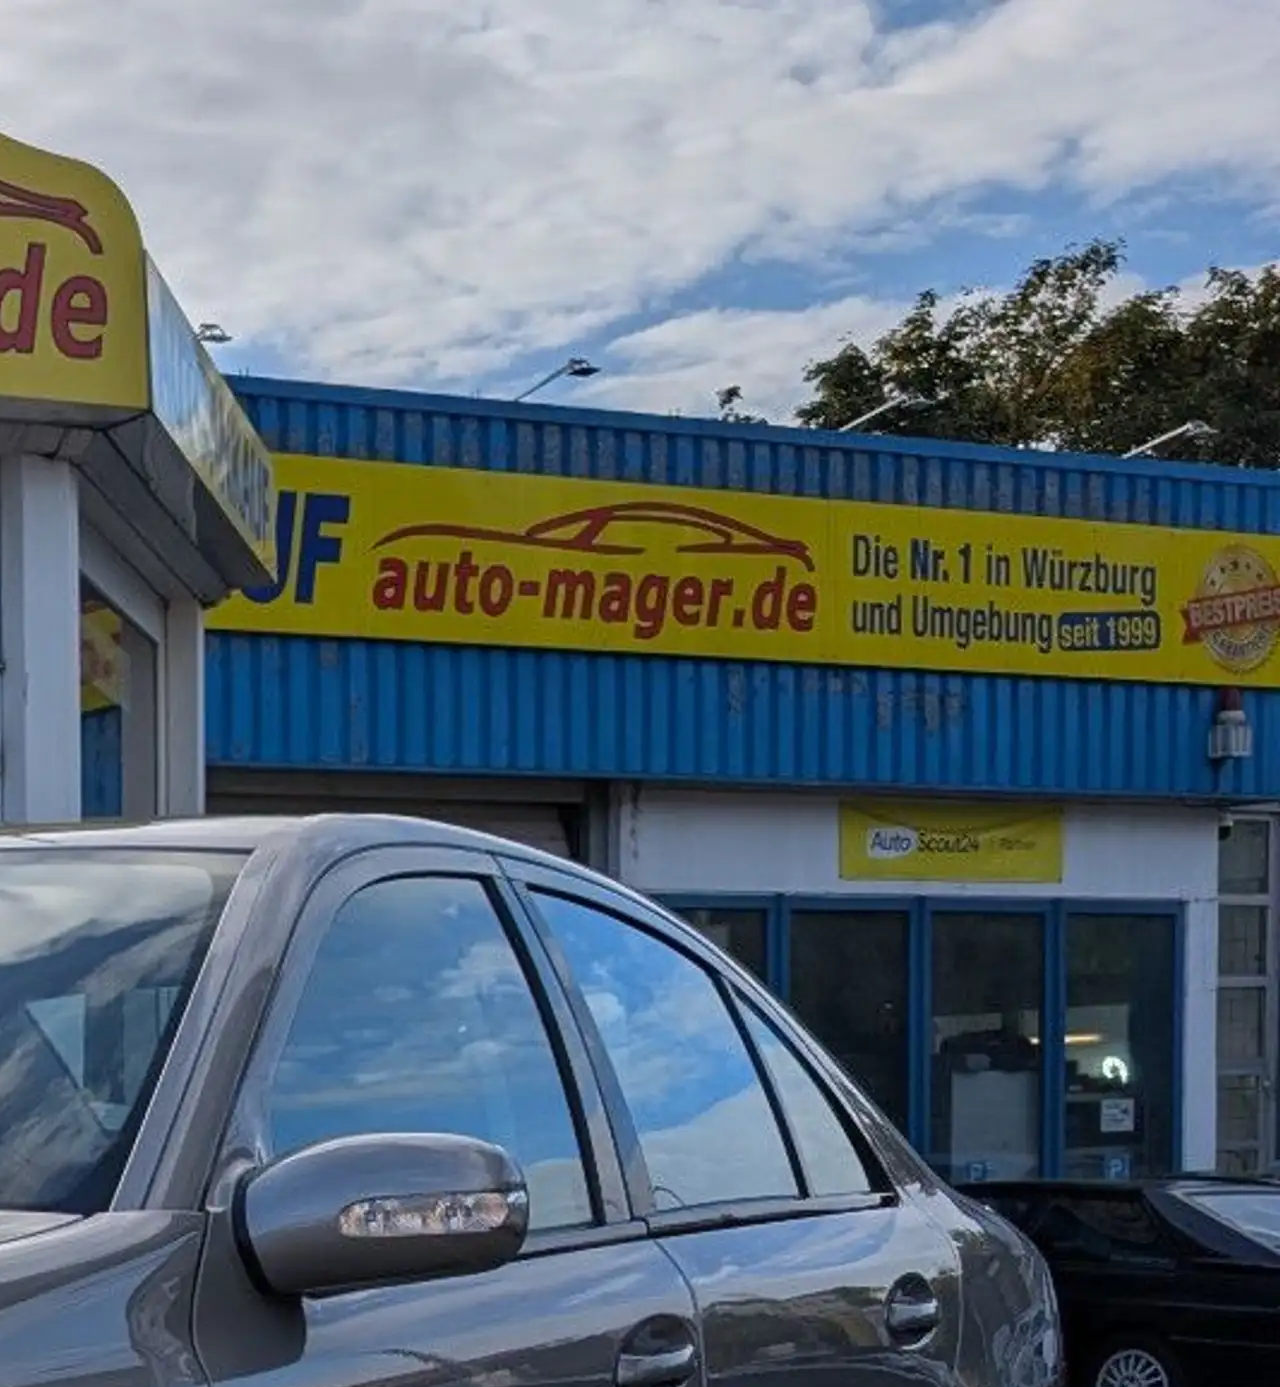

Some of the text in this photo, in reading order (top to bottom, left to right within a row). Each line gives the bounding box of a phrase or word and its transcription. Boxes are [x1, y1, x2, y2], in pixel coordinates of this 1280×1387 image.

[371, 550, 818, 640] auto-mager.de
[851, 534, 1158, 606] Die Nr. 1 in Würzburg
[852, 595, 1158, 653] und Umgebung seit 1999
